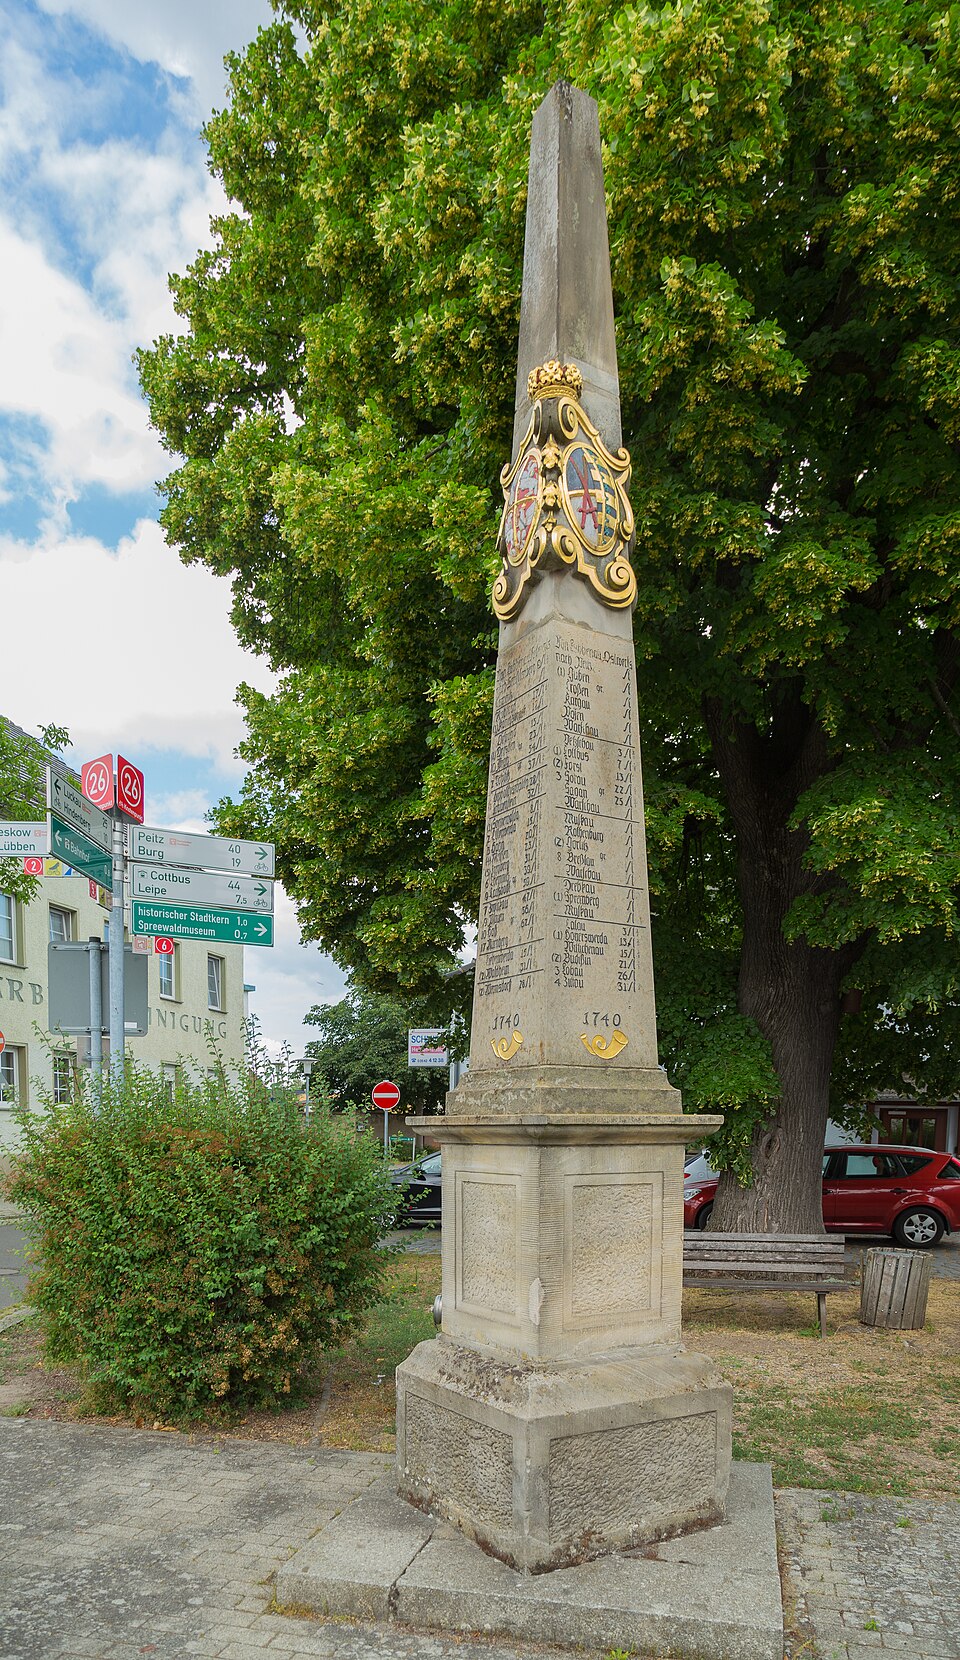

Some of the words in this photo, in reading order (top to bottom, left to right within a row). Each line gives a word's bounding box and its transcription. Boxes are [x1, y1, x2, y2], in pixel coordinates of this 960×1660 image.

[89, 768, 106, 797] 26
[124, 772, 138, 801] 26
[138, 831, 165, 845] Peitz
[228, 844, 241, 855] 40
[138, 845, 164, 860] Burg
[231, 857, 241, 868] 19
[138, 883, 167, 898] Leipe
[150, 870, 191, 885] Cottbus
[227, 880, 241, 891] 44
[138, 906, 188, 923] historischer
[190, 911, 230, 925] Stadtkern
[138, 920, 216, 937] Spreewaldmuseum
[493, 1013, 519, 1030] 1740
[583, 1011, 621, 1027] 1740
